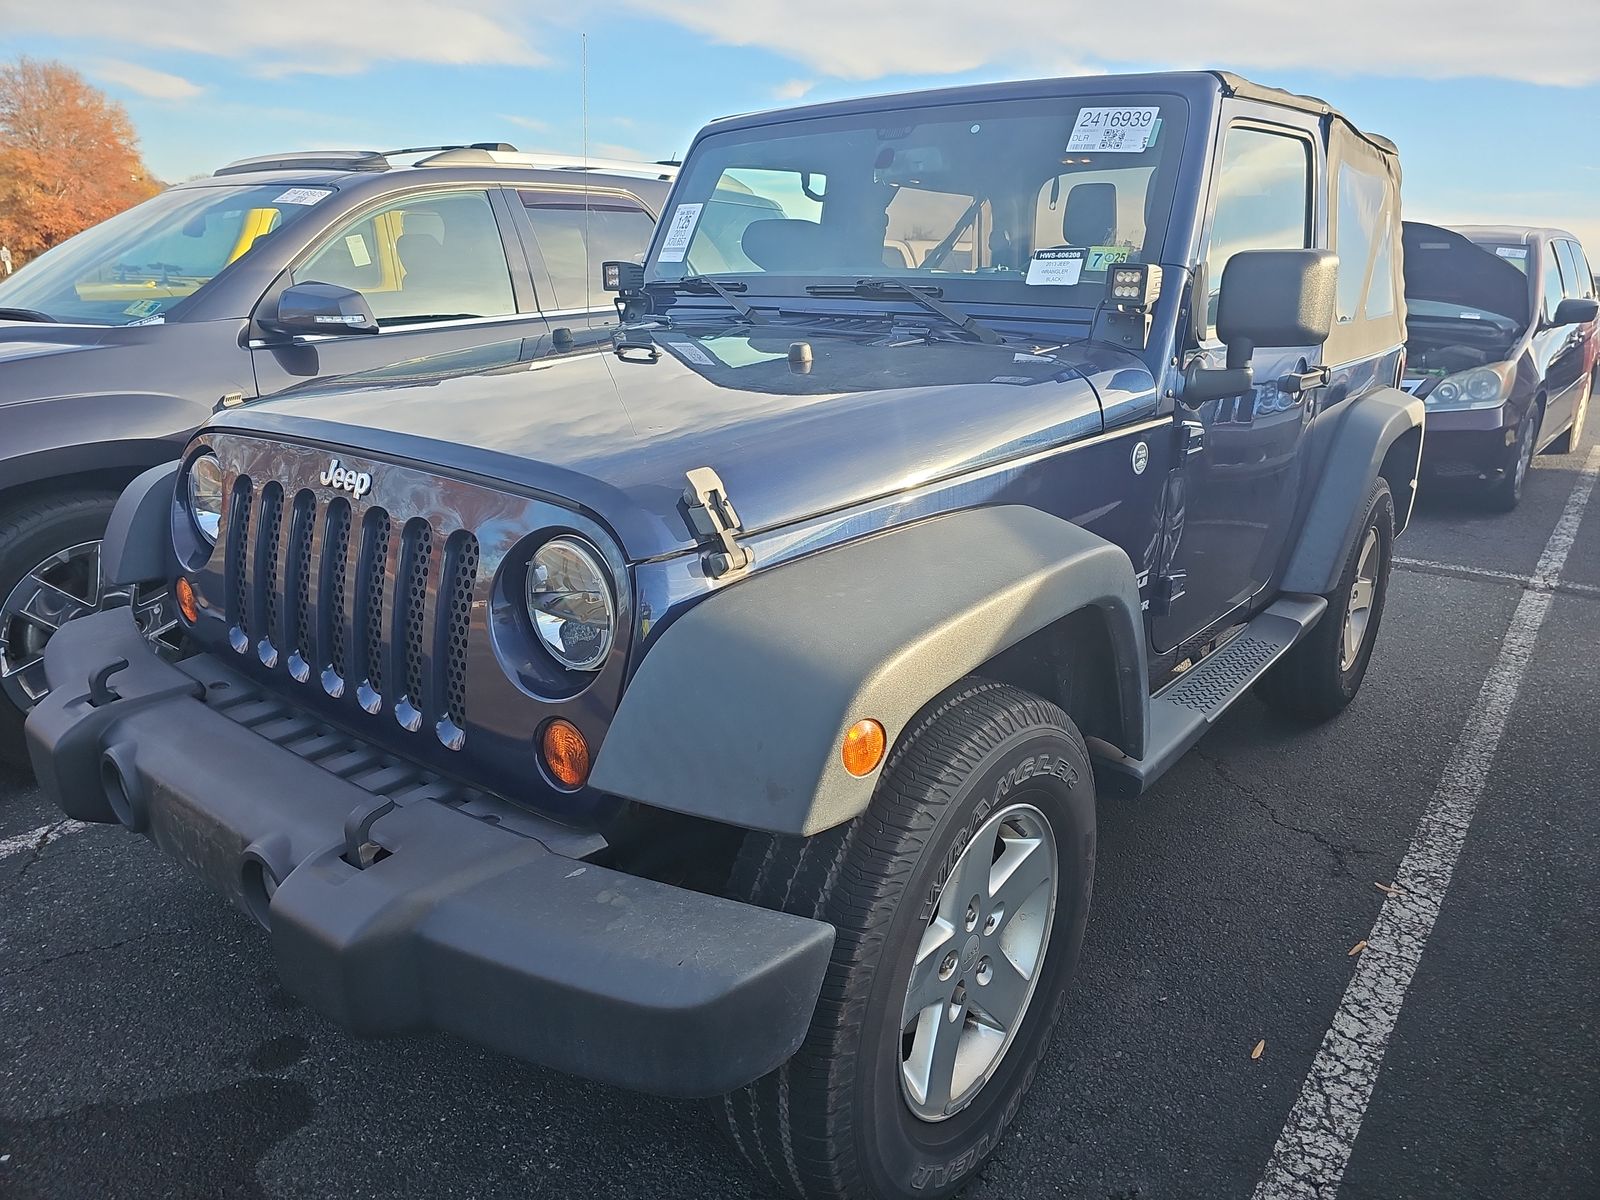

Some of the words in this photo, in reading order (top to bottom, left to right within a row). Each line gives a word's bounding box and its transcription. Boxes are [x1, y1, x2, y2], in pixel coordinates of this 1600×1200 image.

[1080, 112, 1152, 127] 2416939
[1092, 253, 1103, 268] 7
[1113, 252, 1127, 264] 25
[319, 459, 372, 500] Jeep
